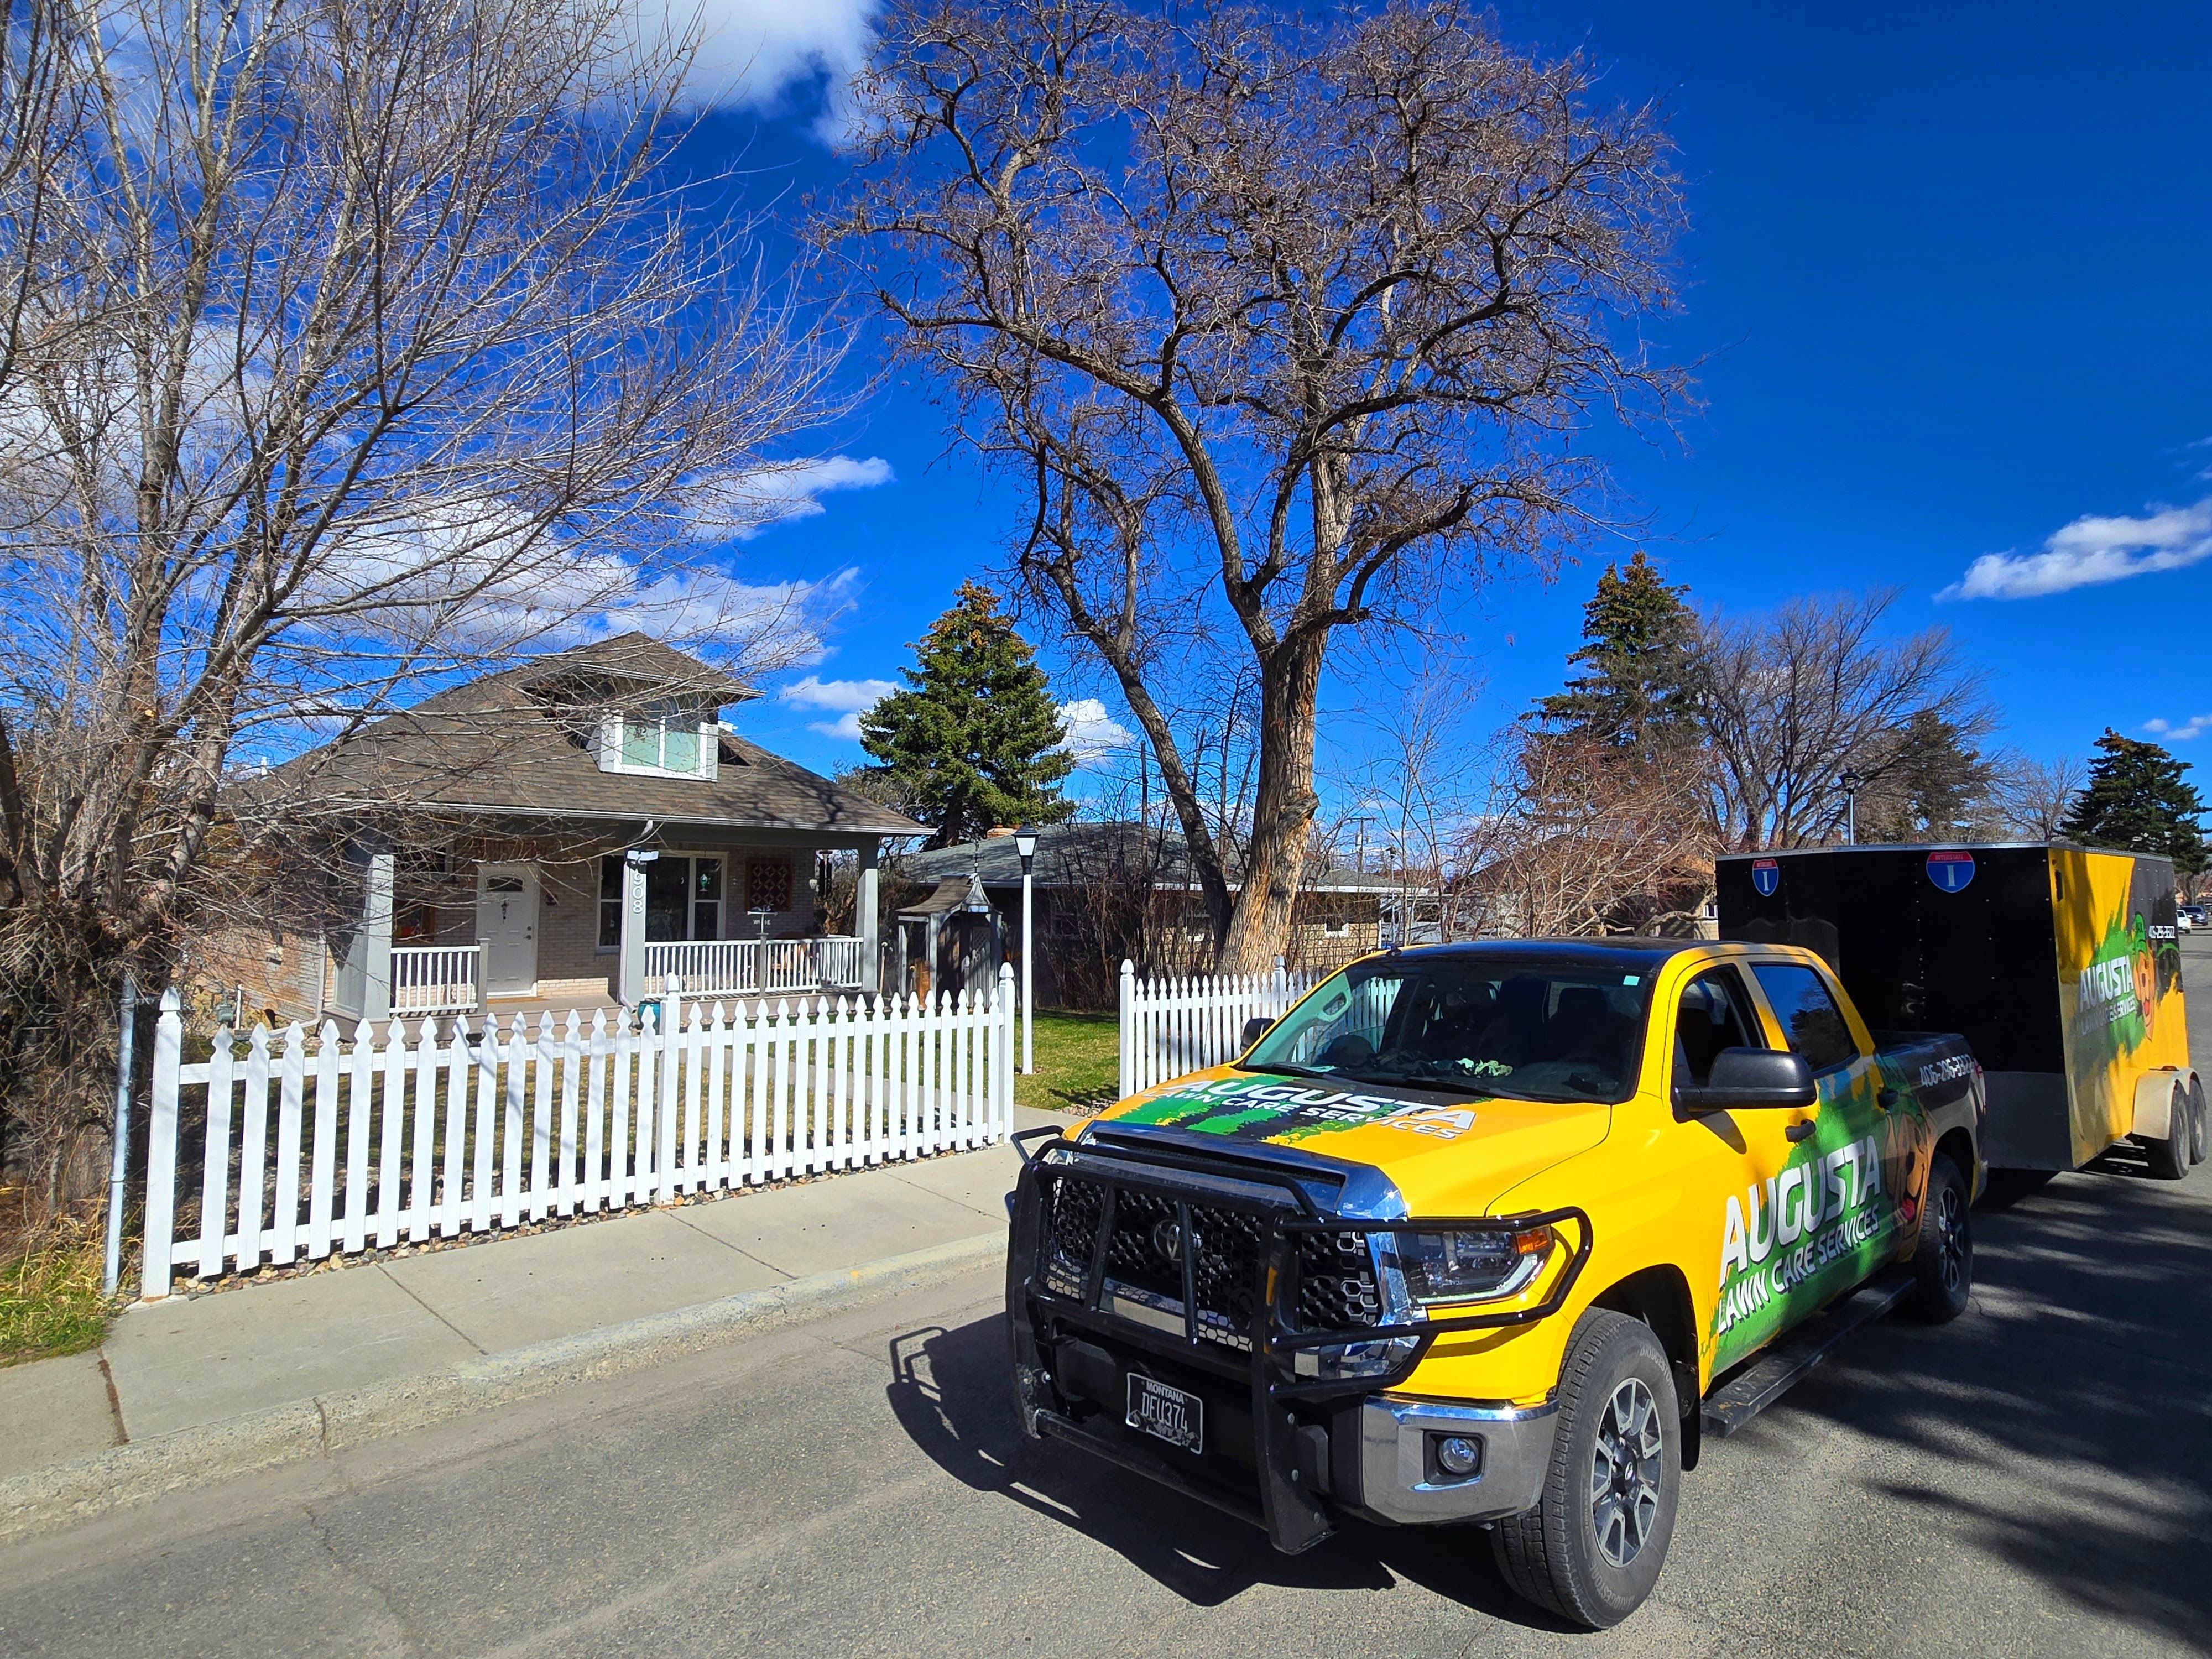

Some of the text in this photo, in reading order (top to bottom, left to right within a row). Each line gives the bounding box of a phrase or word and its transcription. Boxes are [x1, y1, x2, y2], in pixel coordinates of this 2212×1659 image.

[2080, 955, 2134, 1013] AUGUSTA
[1142, 1092, 1463, 1139] LAWN CARE SERVICES
[1160, 1080, 1475, 1130] AUGUSTA
[1719, 1135, 1880, 1291] AUGUSTA
[1718, 1203, 1879, 1334] LAWN CARE SERVICES
[1146, 1381, 1184, 1404] MONTANA
[1588, 1558, 1635, 1610] BRIDGESTONE
